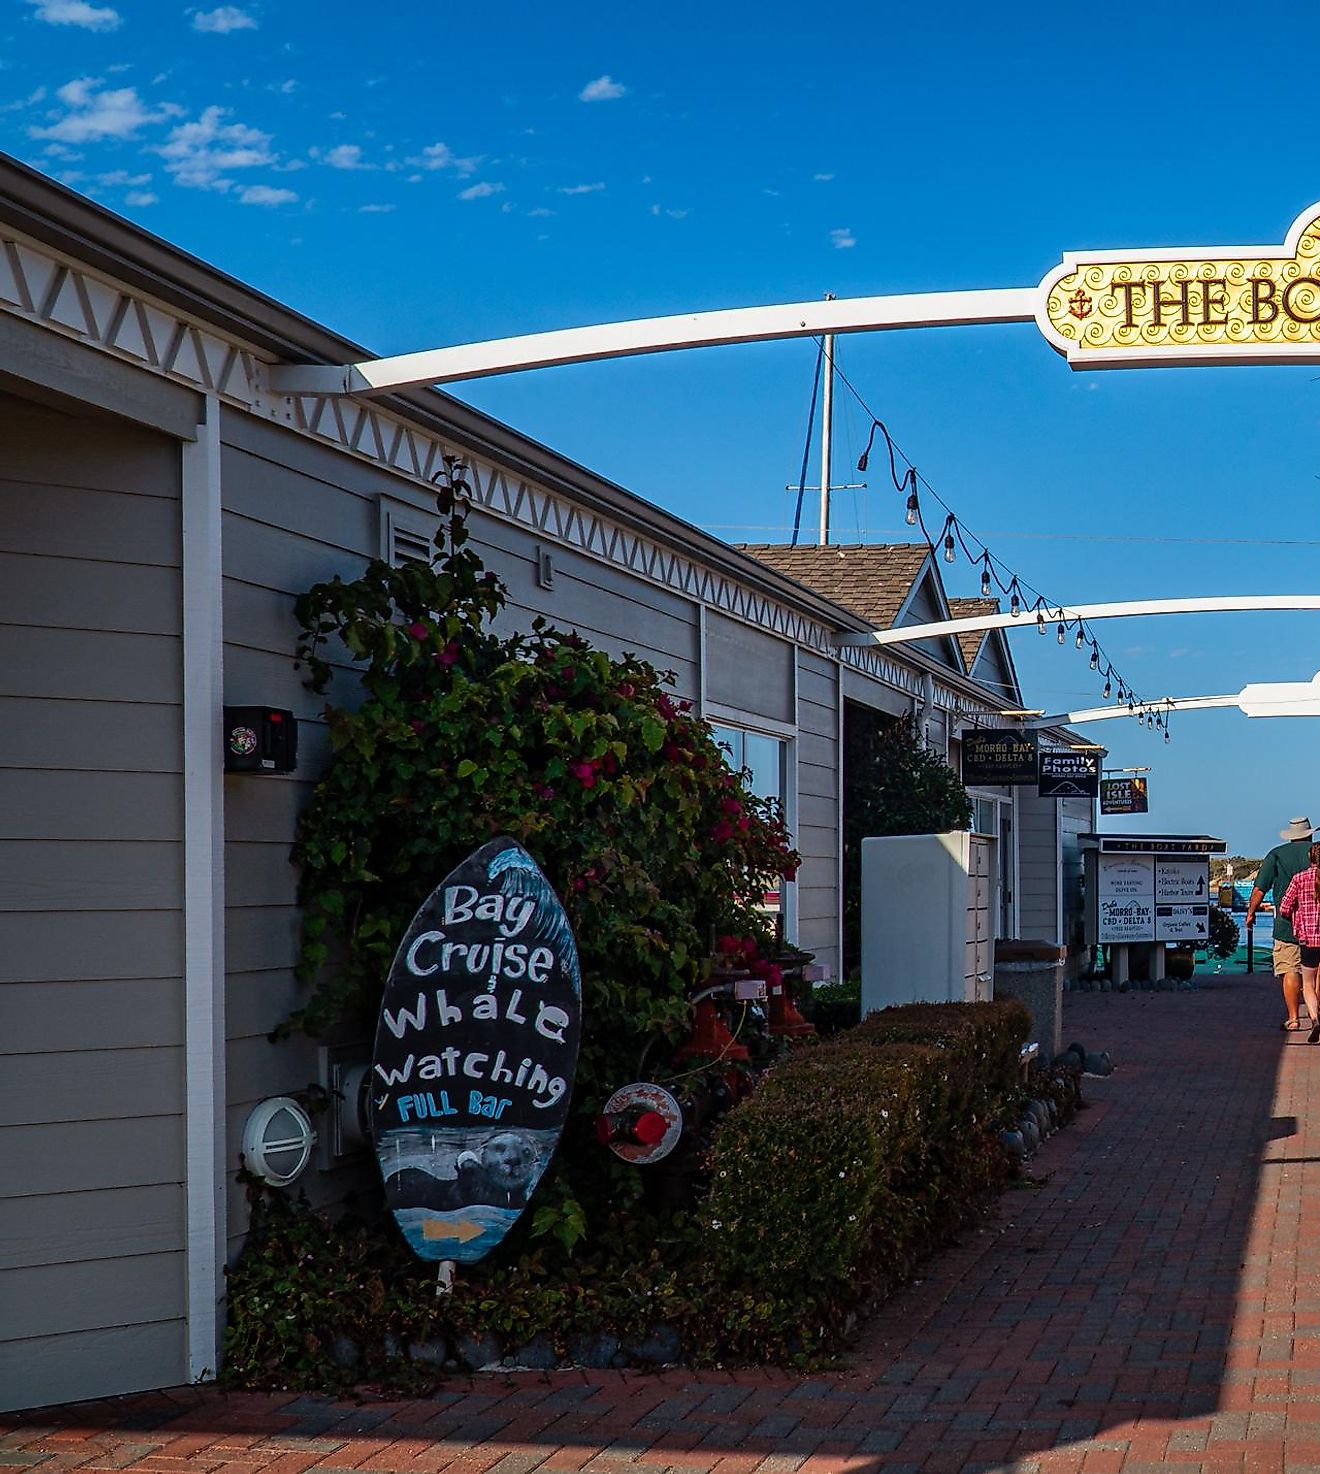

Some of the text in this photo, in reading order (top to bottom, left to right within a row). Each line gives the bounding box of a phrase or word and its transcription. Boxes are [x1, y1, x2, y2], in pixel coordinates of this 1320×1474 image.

[1110, 278, 1229, 328] THE
[975, 743, 1030, 753] MORRO BAY
[995, 753, 1025, 762] DELTA
[1044, 756, 1095, 767] Family
[1042, 764, 1097, 773] Photos
[1107, 782, 1131, 791] LOST
[1106, 789, 1132, 800] ISLE
[1181, 843, 1208, 852] YARD
[444, 885, 538, 937] Bay
[1109, 907, 1133, 917] MORRO
[1136, 907, 1150, 916] BAY
[1102, 917, 1118, 926] CBD
[1123, 916, 1145, 925] DELTA
[406, 930, 554, 983] Cruise
[396, 1090, 459, 1122] FULL
[468, 1090, 513, 1120] Bar
